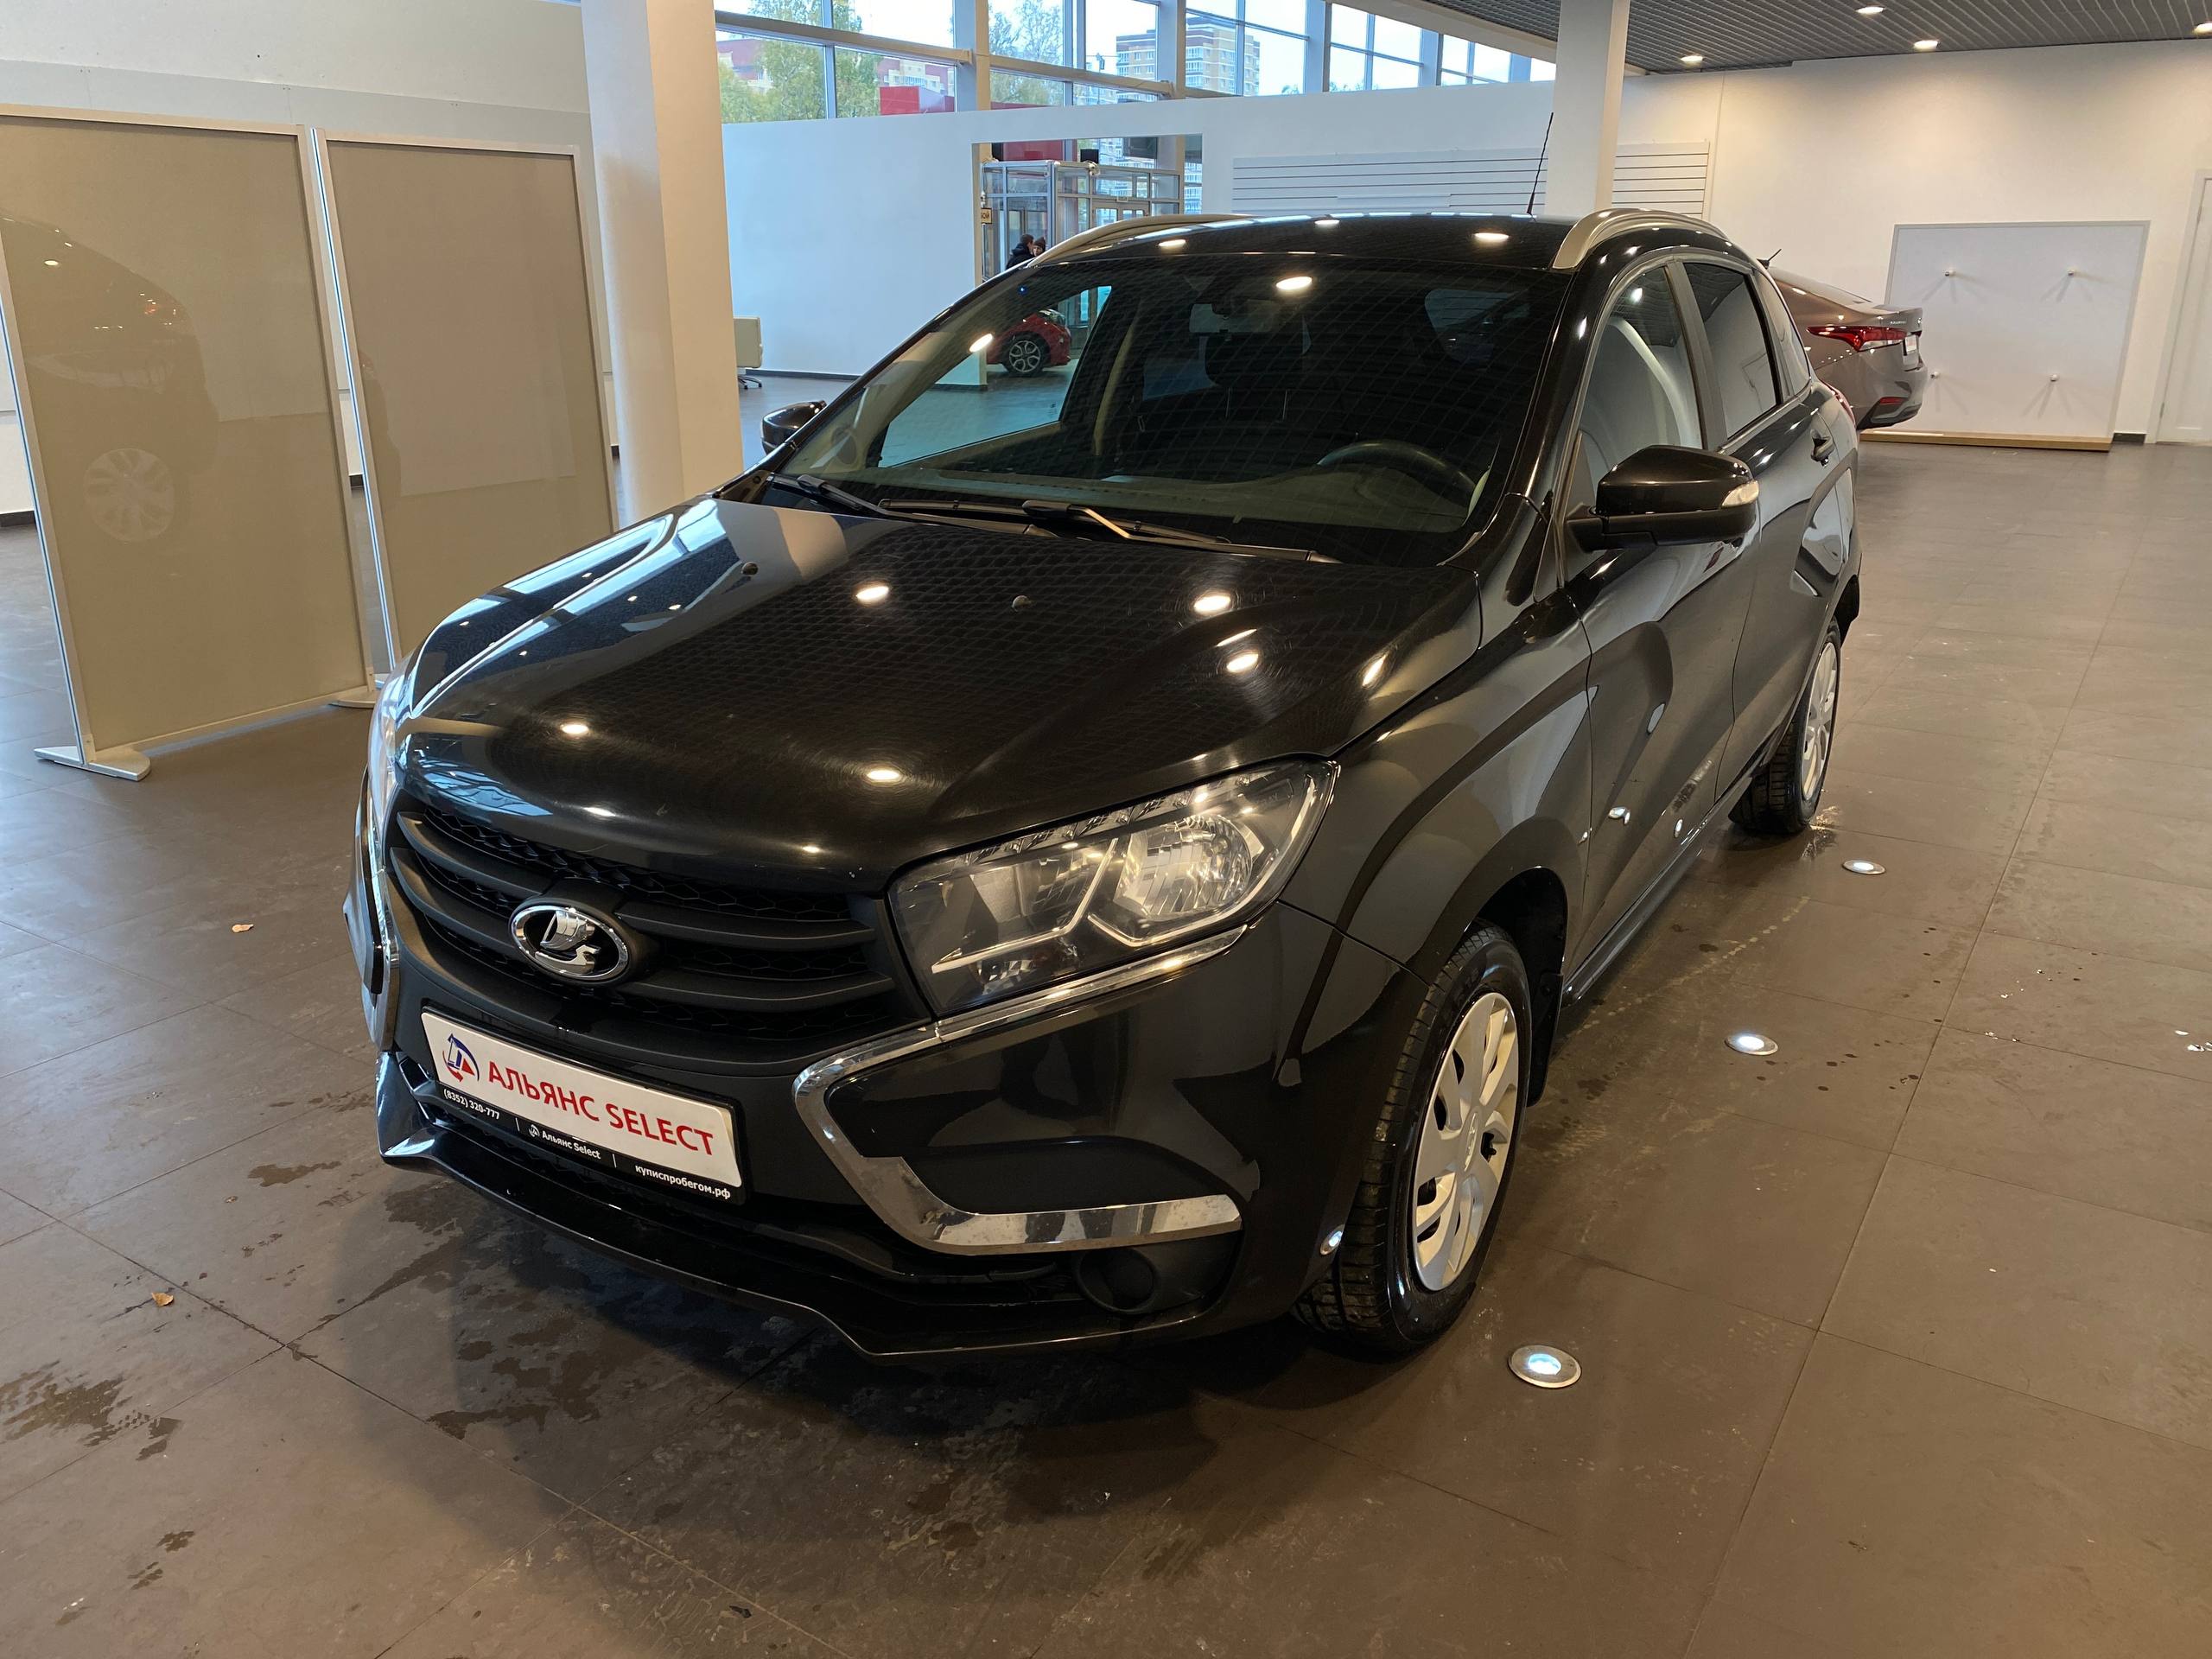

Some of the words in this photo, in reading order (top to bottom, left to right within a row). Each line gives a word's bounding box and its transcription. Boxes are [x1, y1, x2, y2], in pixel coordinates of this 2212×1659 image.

[443, 1089, 468, 1109] (8352)
[469, 1100, 500, 1120] 320-777
[488, 1060, 600, 1122] АЛЬЯНС
[605, 1103, 714, 1156] SELECT
[542, 1130, 573, 1149] Альянс
[573, 1142, 601, 1160] Select
[635, 1165, 731, 1200] куписпробегом.рф
